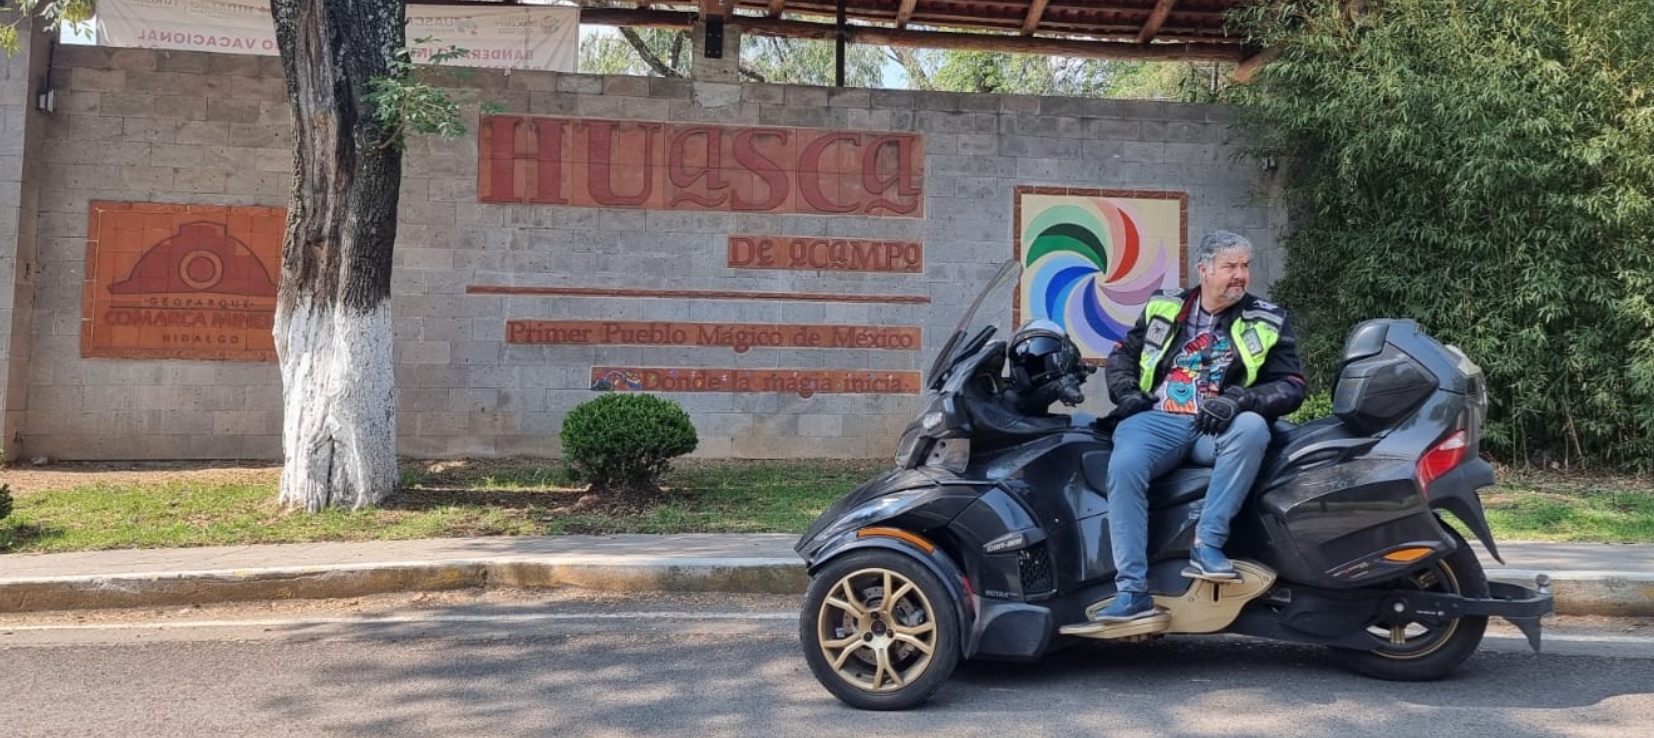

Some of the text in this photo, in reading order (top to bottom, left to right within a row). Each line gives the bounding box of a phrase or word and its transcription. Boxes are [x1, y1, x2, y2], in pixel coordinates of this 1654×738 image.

[150, 297, 249, 308] GEOPARQUE
[104, 310, 206, 327] COMARCA
[162, 334, 239, 345] HIDALGO
[509, 322, 913, 353] Primer Pueblo Mágico de México
[732, 371, 750, 392] la
[763, 374, 834, 399] magia
